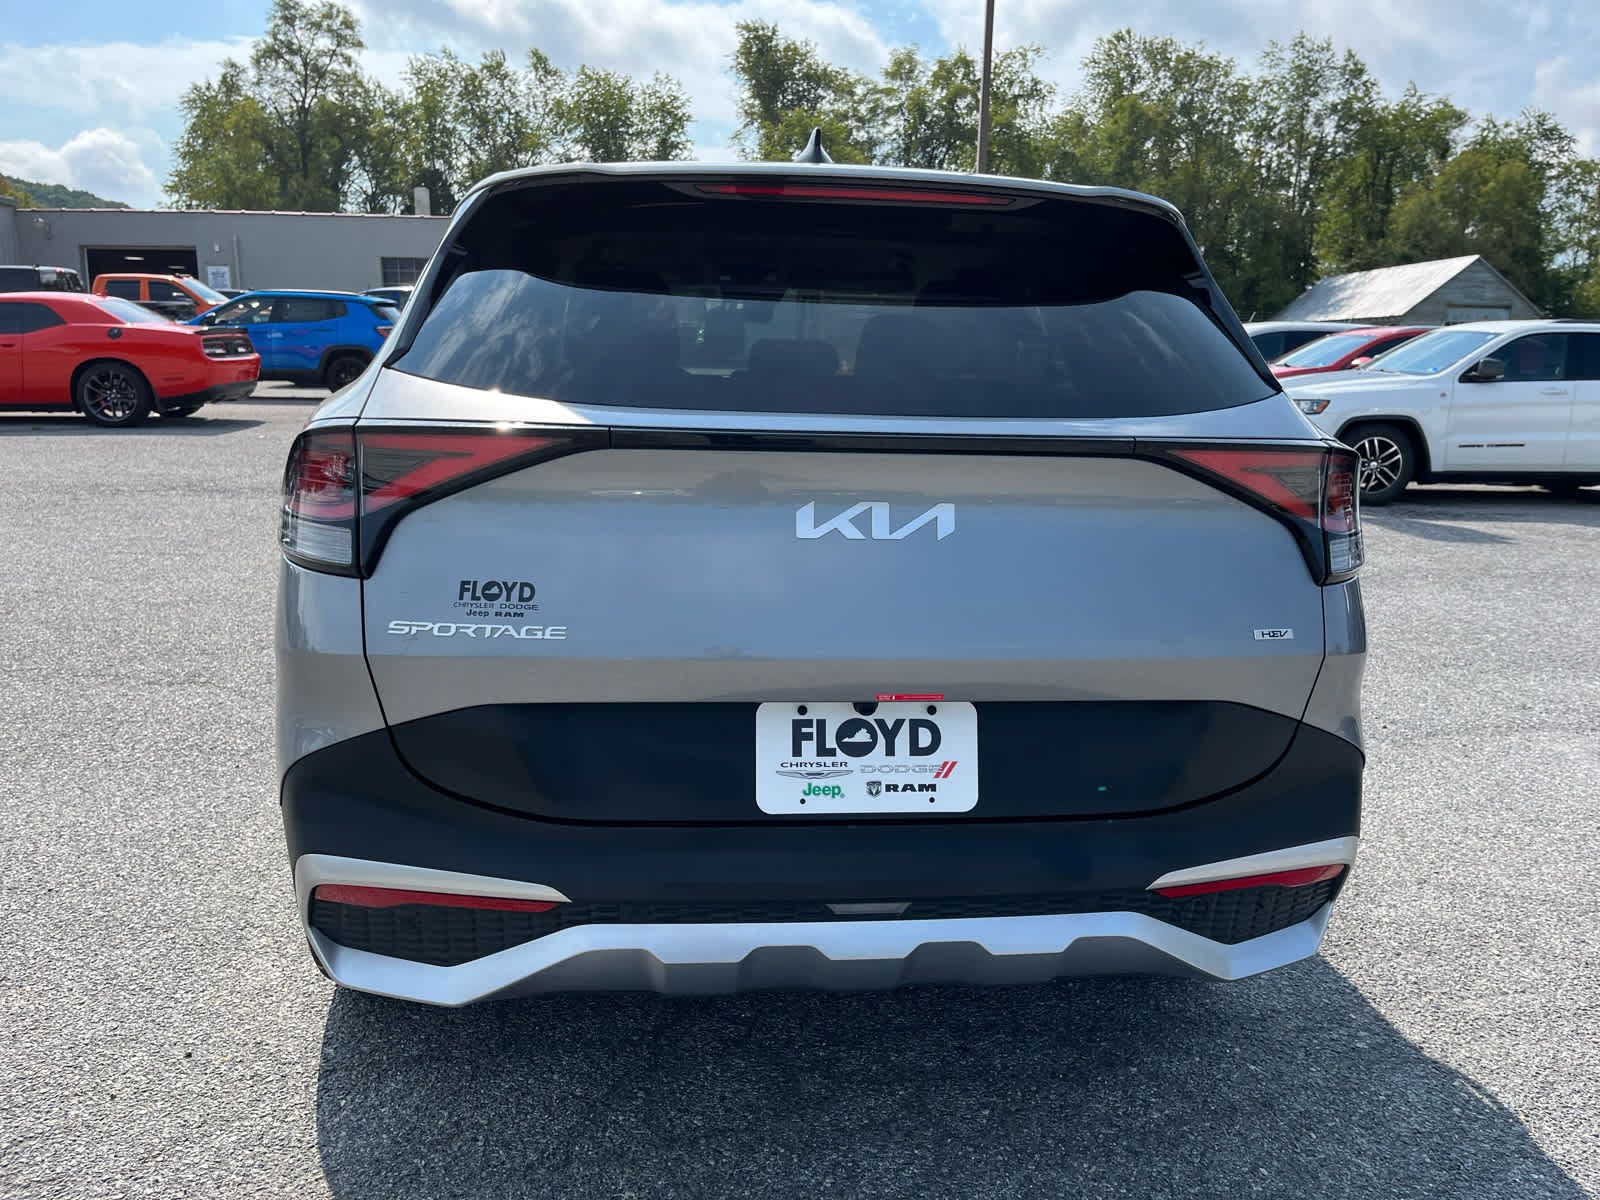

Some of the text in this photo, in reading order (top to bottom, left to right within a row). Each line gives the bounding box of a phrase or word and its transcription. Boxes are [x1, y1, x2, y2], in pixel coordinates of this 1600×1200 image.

[458, 580, 536, 603] FLOYD
[499, 603, 540, 611] DODGE
[465, 609, 490, 618] Jeep
[387, 620, 568, 640] SPORTAGE
[791, 717, 942, 758] FLOYD
[860, 763, 943, 774] DODGE
[885, 783, 937, 793] RAM
